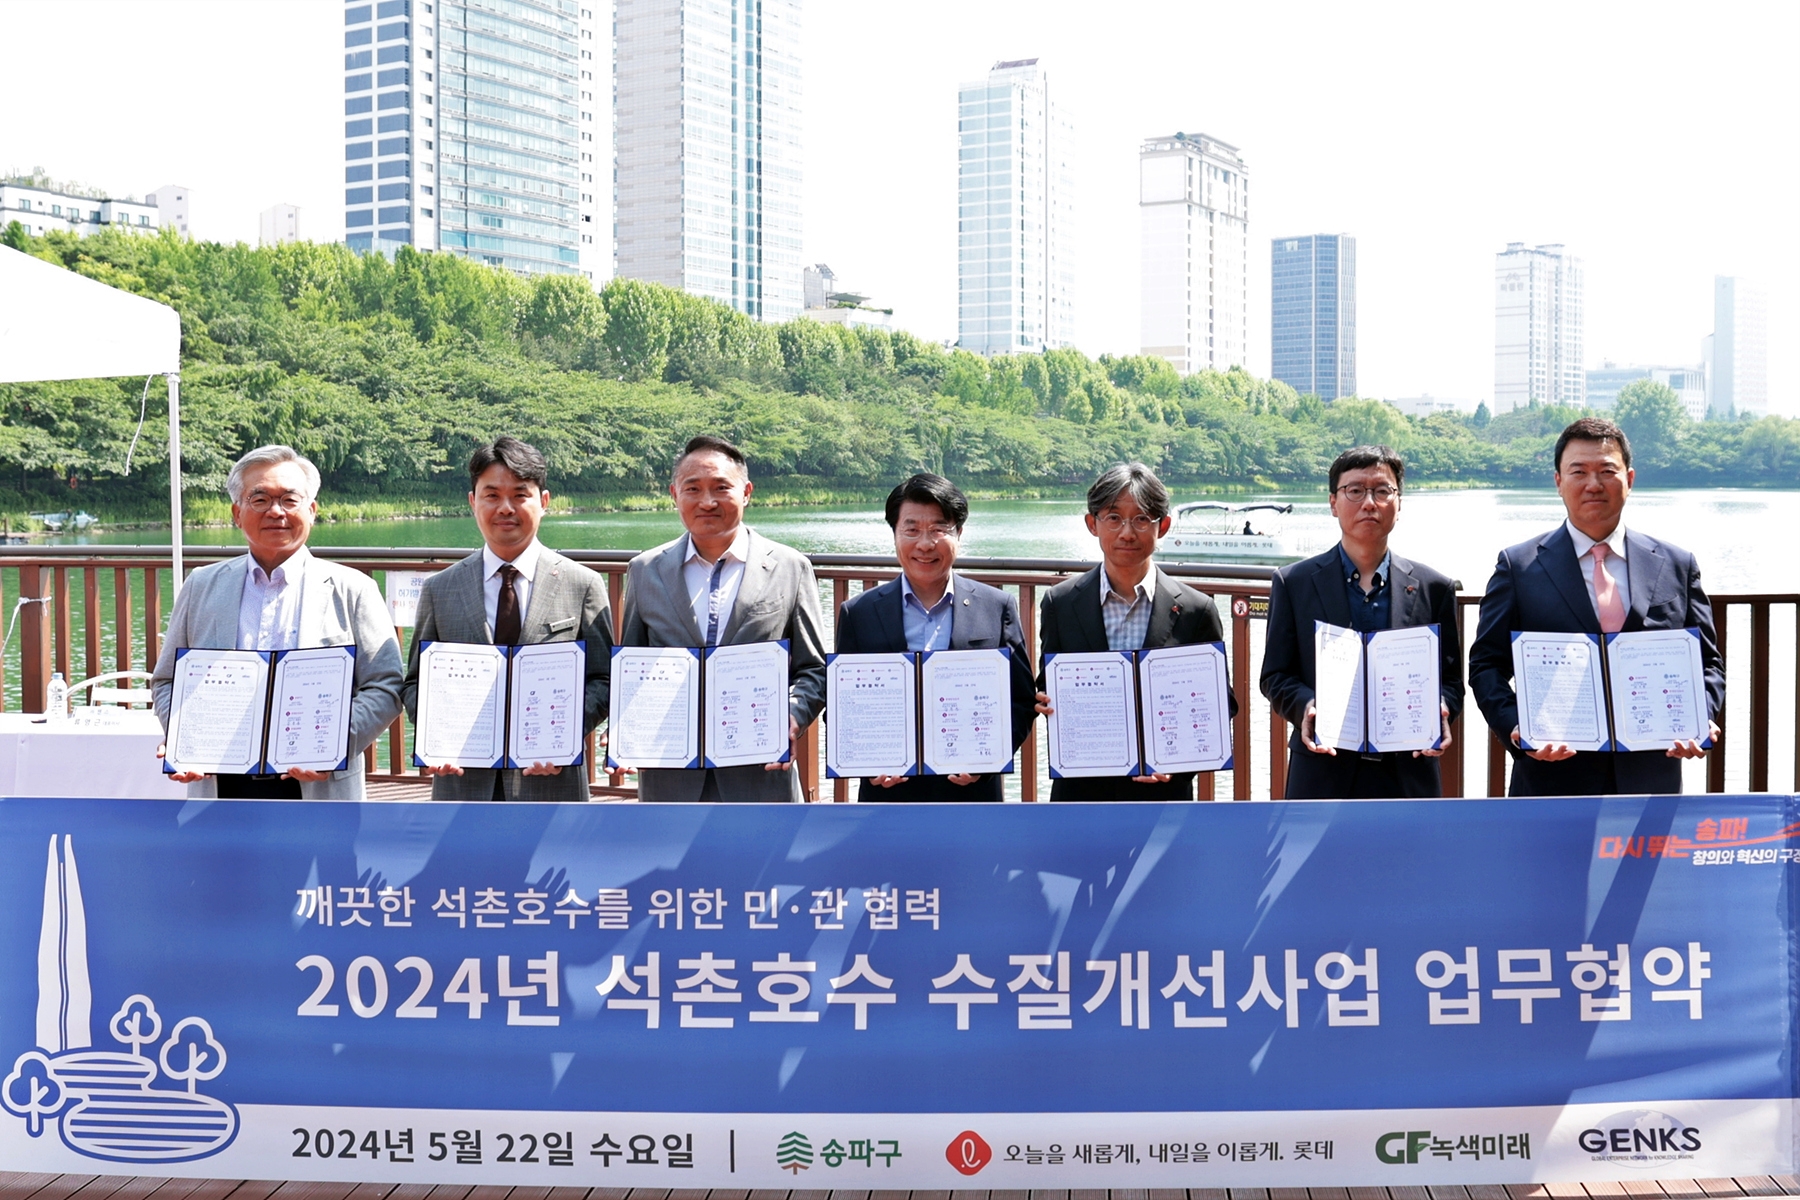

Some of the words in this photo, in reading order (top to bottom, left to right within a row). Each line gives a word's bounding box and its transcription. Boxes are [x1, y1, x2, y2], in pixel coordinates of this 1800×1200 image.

[1695, 818, 1748, 841] 송파!
[1599, 836, 1645, 858] 다시
[1647, 835, 1692, 858] 뛰는
[1692, 849, 1735, 865] 창의와
[1736, 848, 1777, 864] 혁신의
[296, 885, 415, 927] 깨끗한
[432, 887, 631, 929] 석촌호수를
[648, 888, 727, 930] 위한
[863, 888, 939, 930] 협력
[296, 951, 559, 1026] 2024년
[595, 951, 897, 1029] 석촌호수
[928, 949, 1380, 1030] 수질개선사업
[1415, 944, 1711, 1025] 업무협약
[292, 1127, 414, 1163] 2024년
[427, 1130, 483, 1165] 5월
[496, 1132, 573, 1166] 22일
[589, 1133, 693, 1168] 수요일
[820, 1138, 903, 1168] 송파구
[1003, 1143, 1066, 1165] 오늘을
[1072, 1143, 1141, 1165] 새롭게,
[1149, 1142, 1211, 1163] 내일을
[1217, 1141, 1284, 1162] 이롭게.
[1293, 1140, 1334, 1161] 롯데
[1578, 1127, 1702, 1153] GENKS
